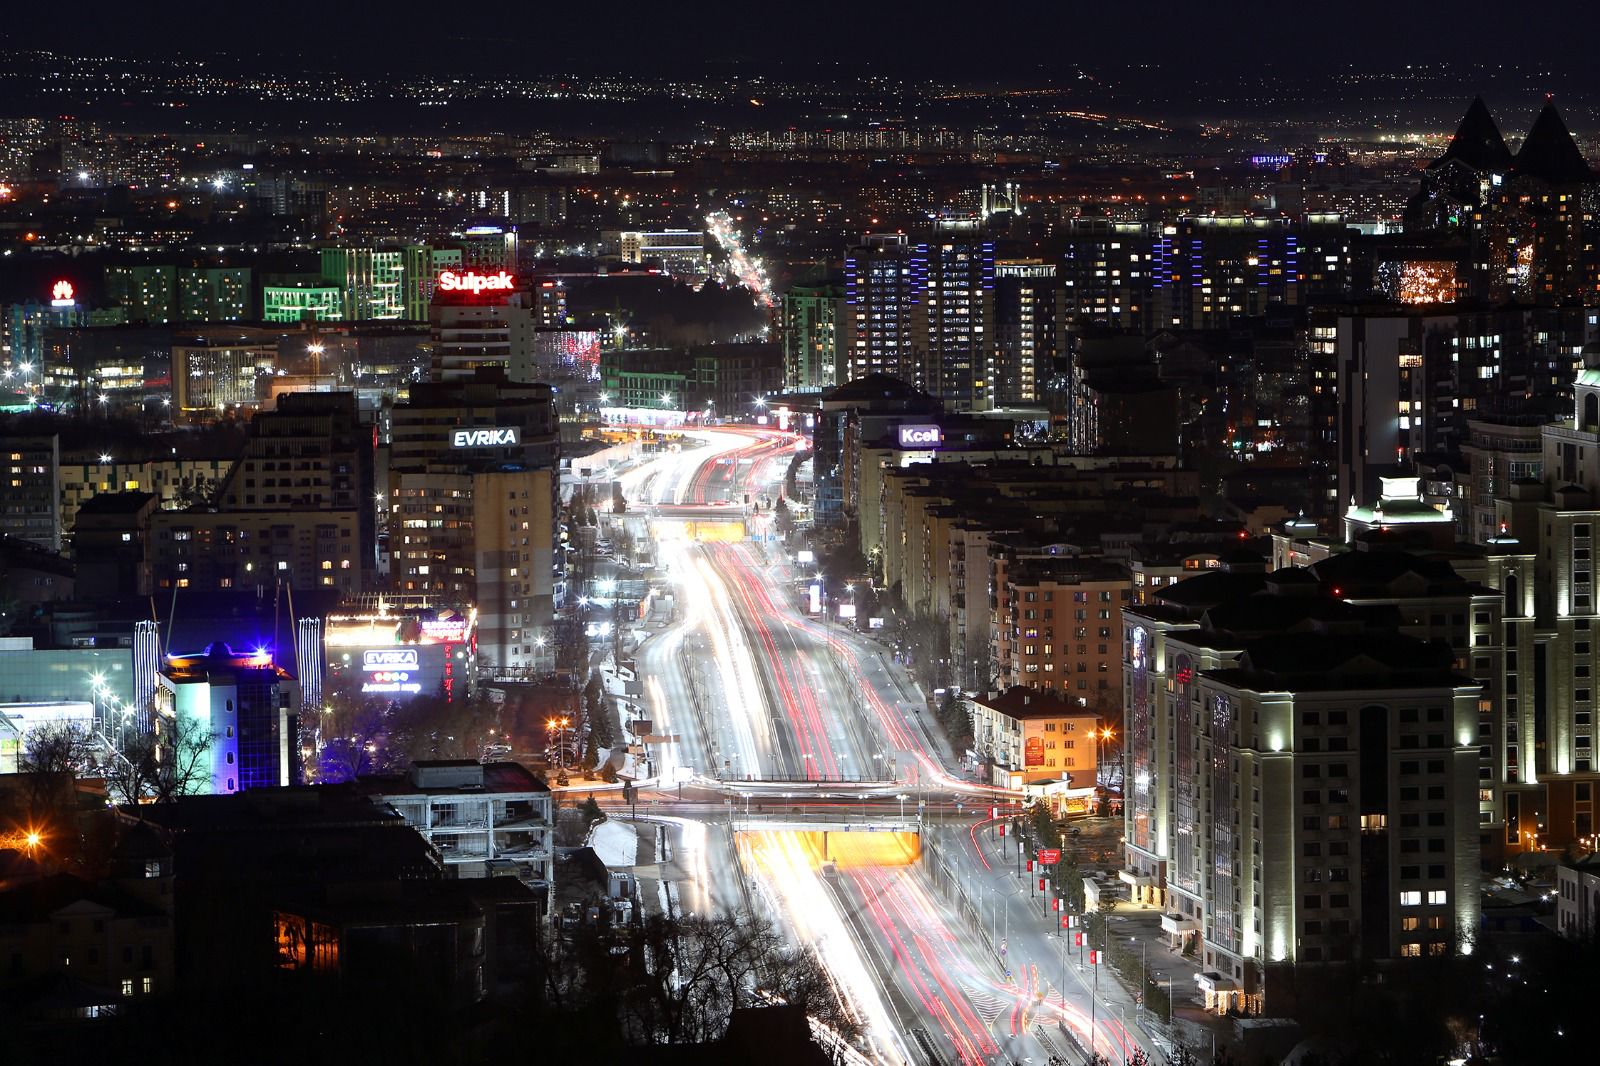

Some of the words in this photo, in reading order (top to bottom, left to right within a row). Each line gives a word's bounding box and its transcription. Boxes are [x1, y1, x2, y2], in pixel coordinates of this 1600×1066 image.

[440, 271, 514, 294] Sulpak
[454, 429, 516, 446] EVRIKA
[902, 428, 939, 442] Kcell
[366, 652, 415, 664] EVRIKA
